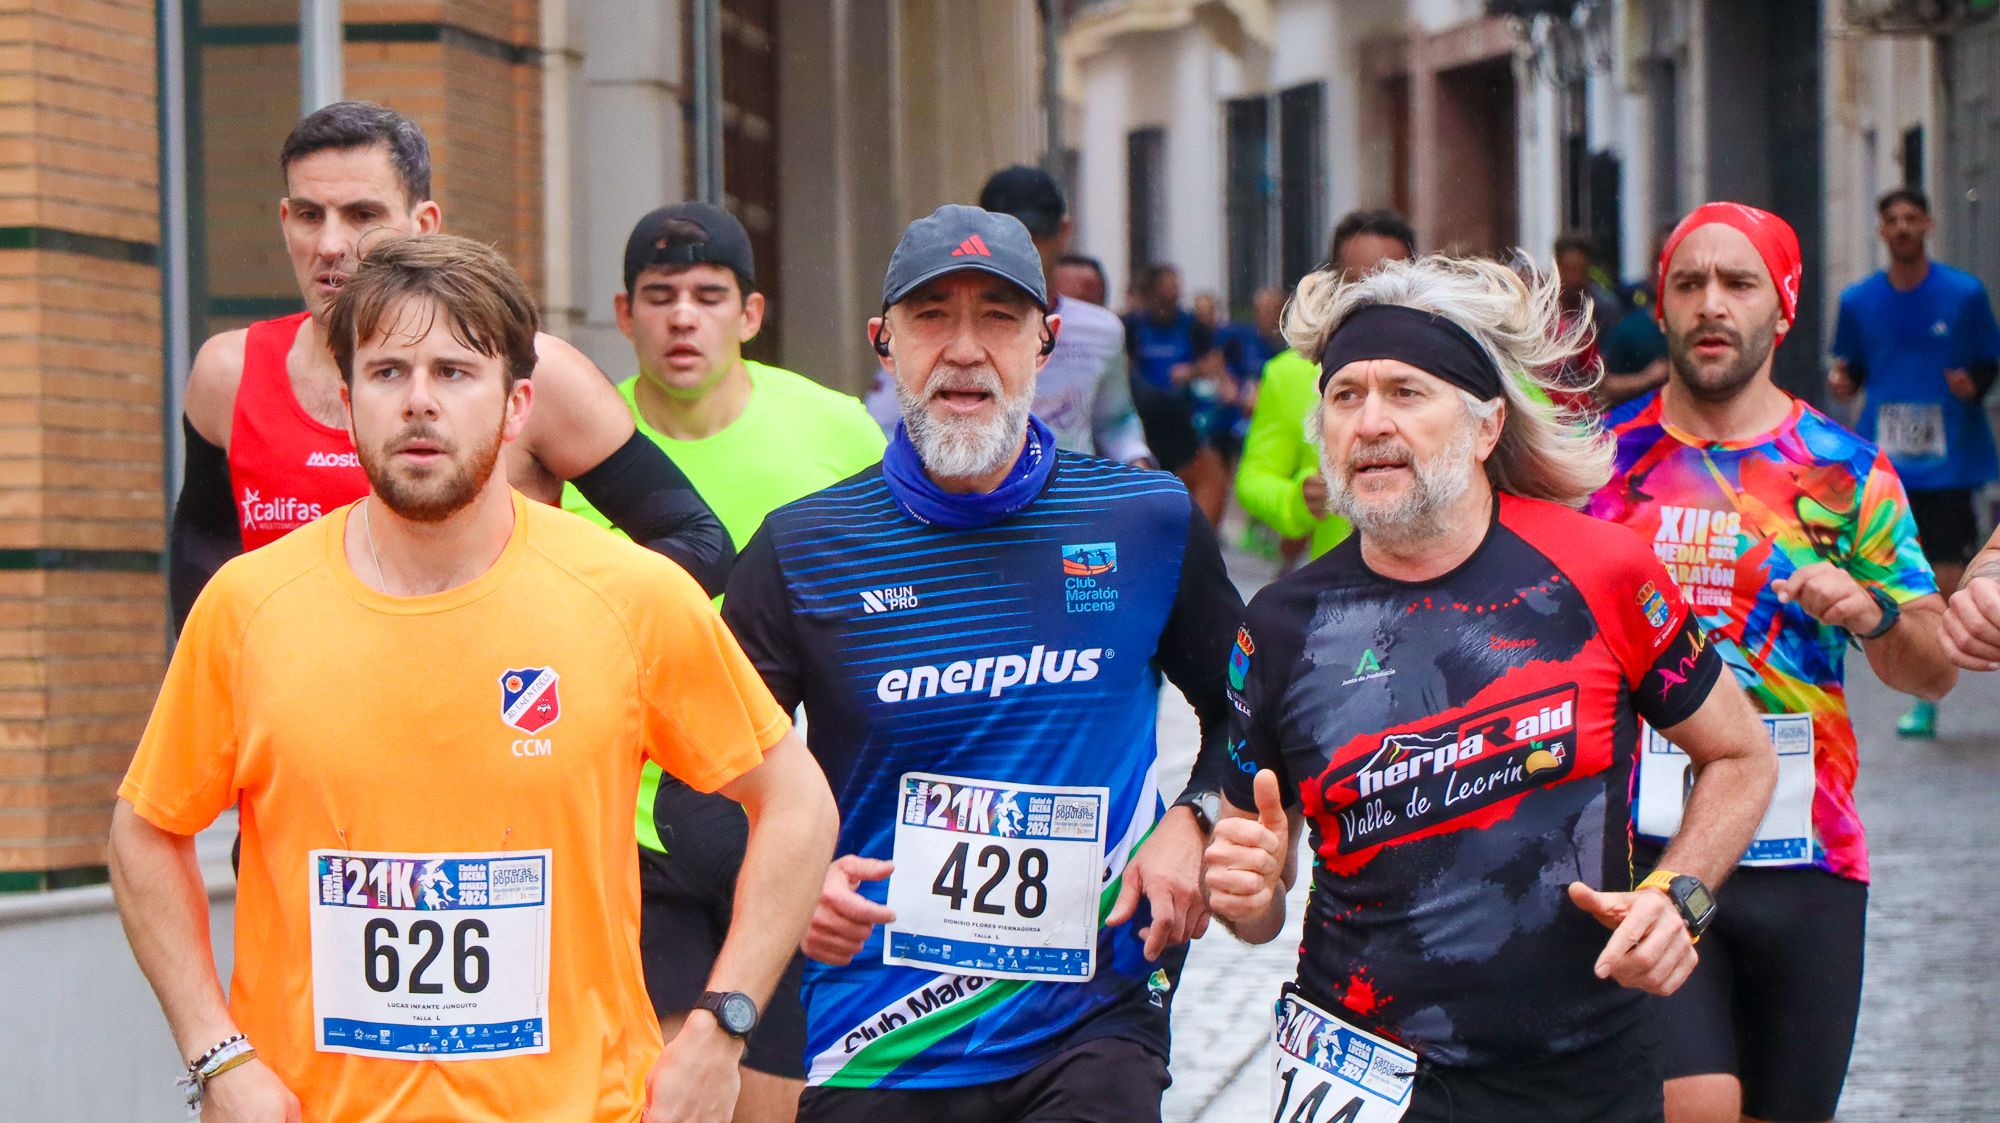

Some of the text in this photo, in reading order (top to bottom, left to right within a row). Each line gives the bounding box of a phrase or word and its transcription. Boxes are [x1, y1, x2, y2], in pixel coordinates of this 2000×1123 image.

[254, 497, 322, 521] califas
[1654, 505, 1741, 545] XII 08
[1652, 541, 1708, 564] MEDIA
[1064, 576, 1097, 590] Club
[1665, 563, 1736, 588] ARATÓN
[884, 585, 913, 600] RUN
[890, 595, 918, 611] PRO
[1065, 586, 1119, 601] Maratón
[1066, 601, 1115, 613] Lucena
[876, 645, 1102, 703] enerplus
[511, 738, 552, 757] CCM
[926, 783, 995, 833] 21K
[1340, 756, 1525, 843] Valle de Lecrín
[1025, 821, 1050, 836] 2026
[345, 858, 417, 908] 21K
[493, 867, 532, 878] carreras
[493, 874, 540, 888] populares
[931, 841, 1049, 918] 428
[458, 890, 488, 906] 2026
[364, 917, 490, 994] 626
